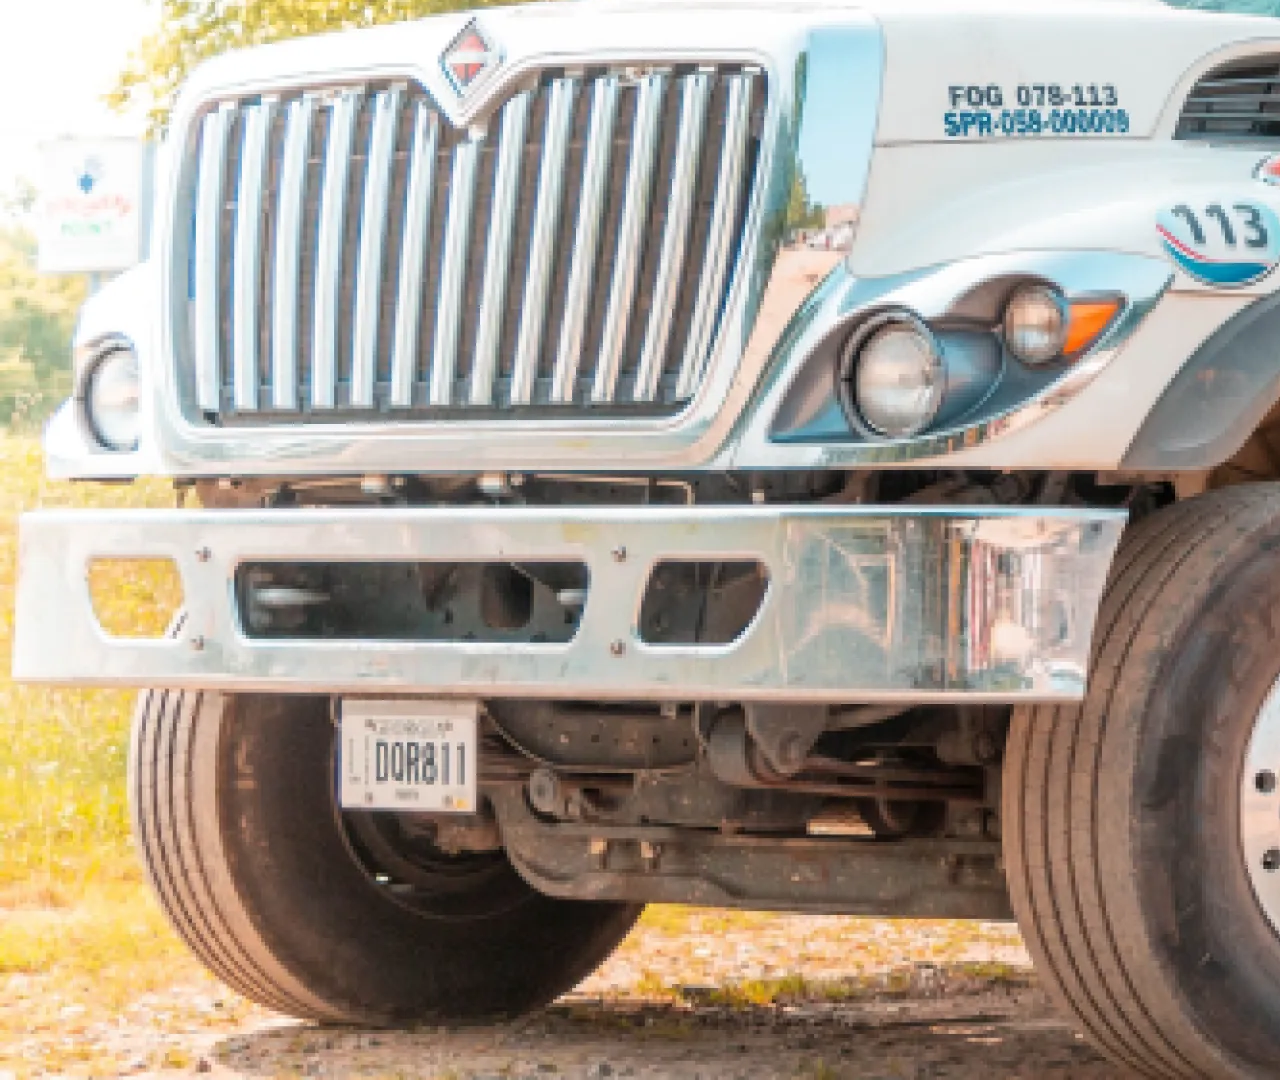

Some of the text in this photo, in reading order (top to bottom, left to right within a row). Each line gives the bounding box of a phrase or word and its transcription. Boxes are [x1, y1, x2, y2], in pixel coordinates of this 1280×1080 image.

[947, 83, 1119, 107] FOG 078-113
[1171, 203, 1269, 249] 113
